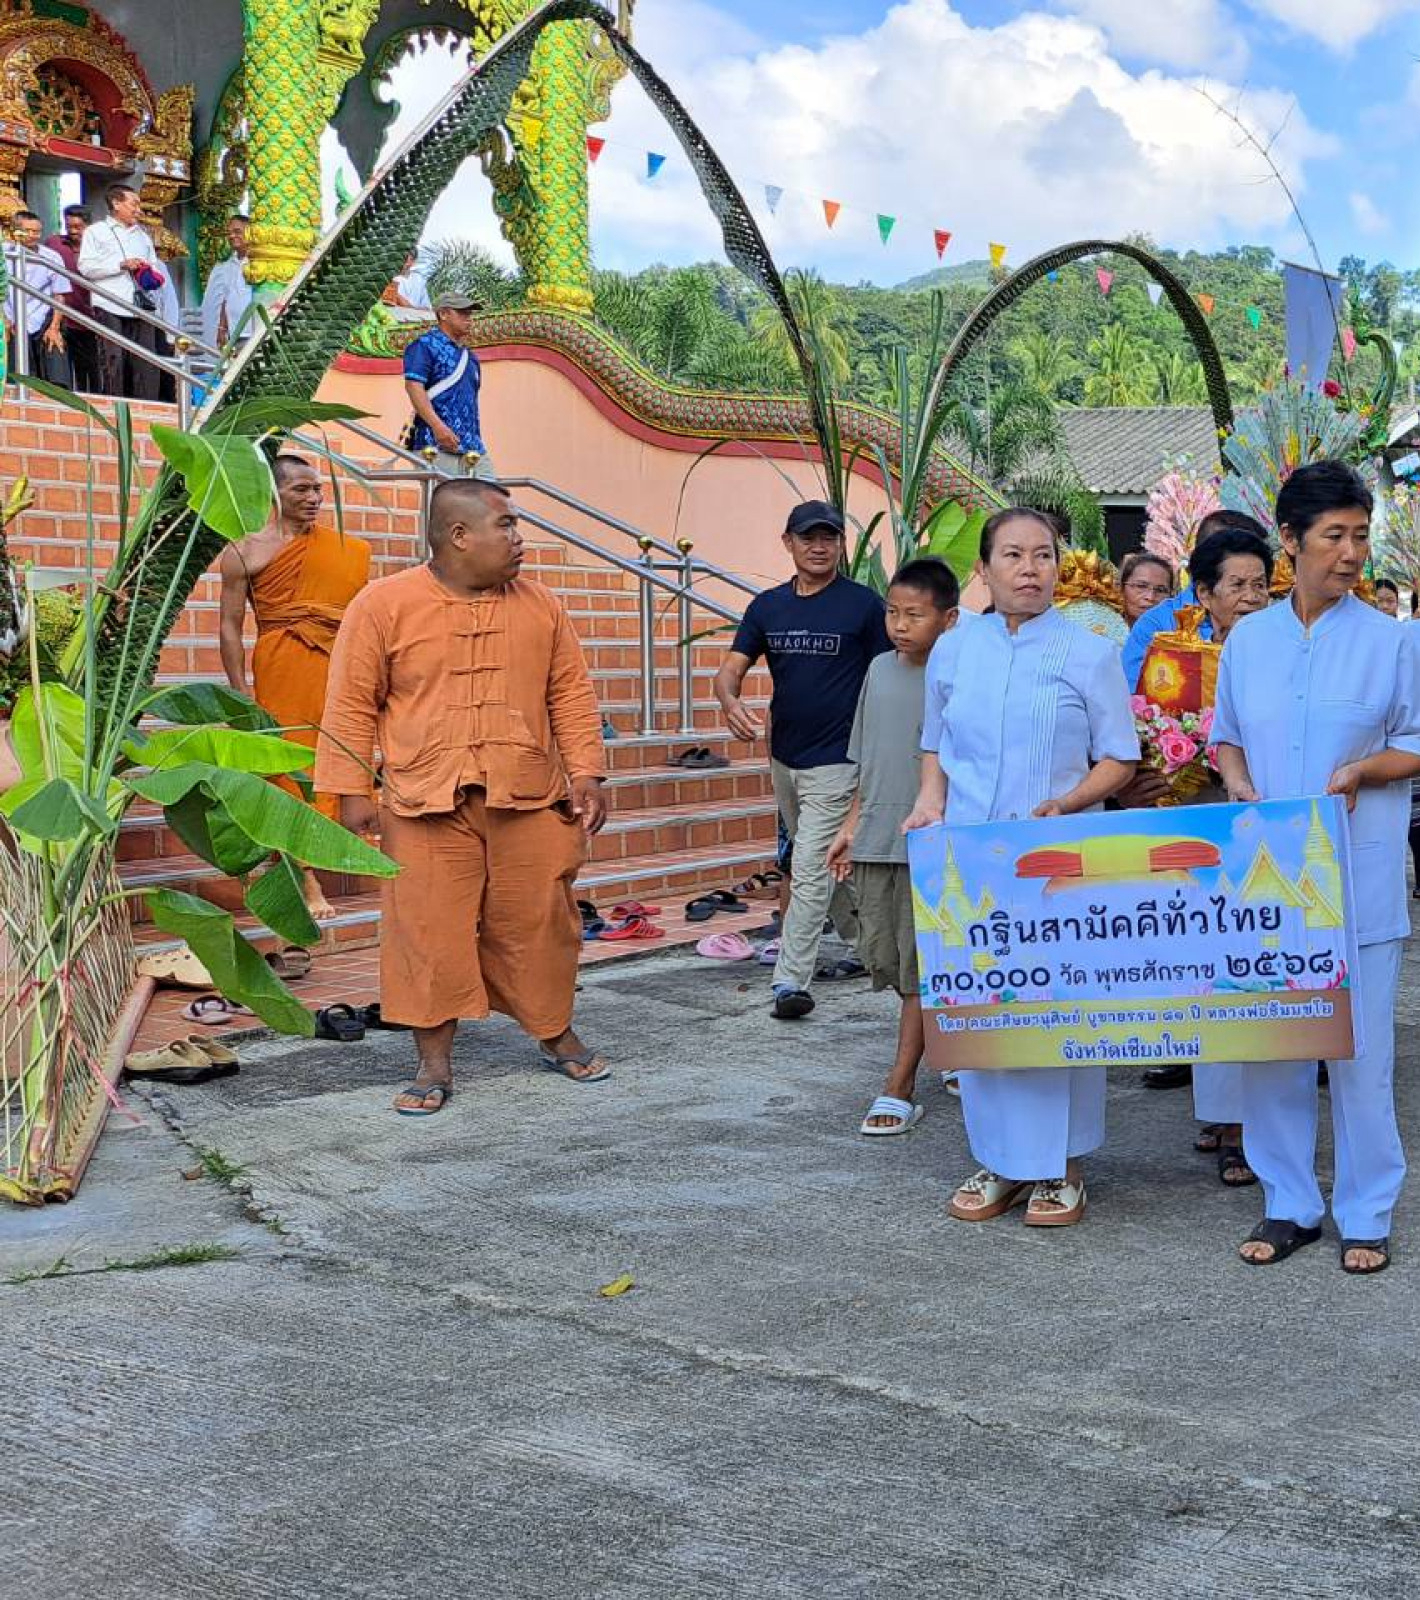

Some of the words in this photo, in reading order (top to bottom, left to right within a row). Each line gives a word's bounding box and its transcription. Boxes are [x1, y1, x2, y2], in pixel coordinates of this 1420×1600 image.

[968, 889, 1282, 957] กฐินสามัคคีทั่วไทย
[931, 966, 1051, 995] ๓๐,๐๐๐
[1060, 962, 1087, 986] วัด
[1094, 958, 1216, 992] พุทธศักราช
[1225, 949, 1335, 978] ๒๕๖๘
[937, 1012, 964, 1031] โดย
[969, 1007, 1082, 1030] คณะศิษยานุศิษย์
[1086, 1008, 1157, 1029] บูชาธรรม
[1189, 1003, 1202, 1019] ปี
[1062, 1032, 1201, 1061] จังหวัดเชียงใหม่
